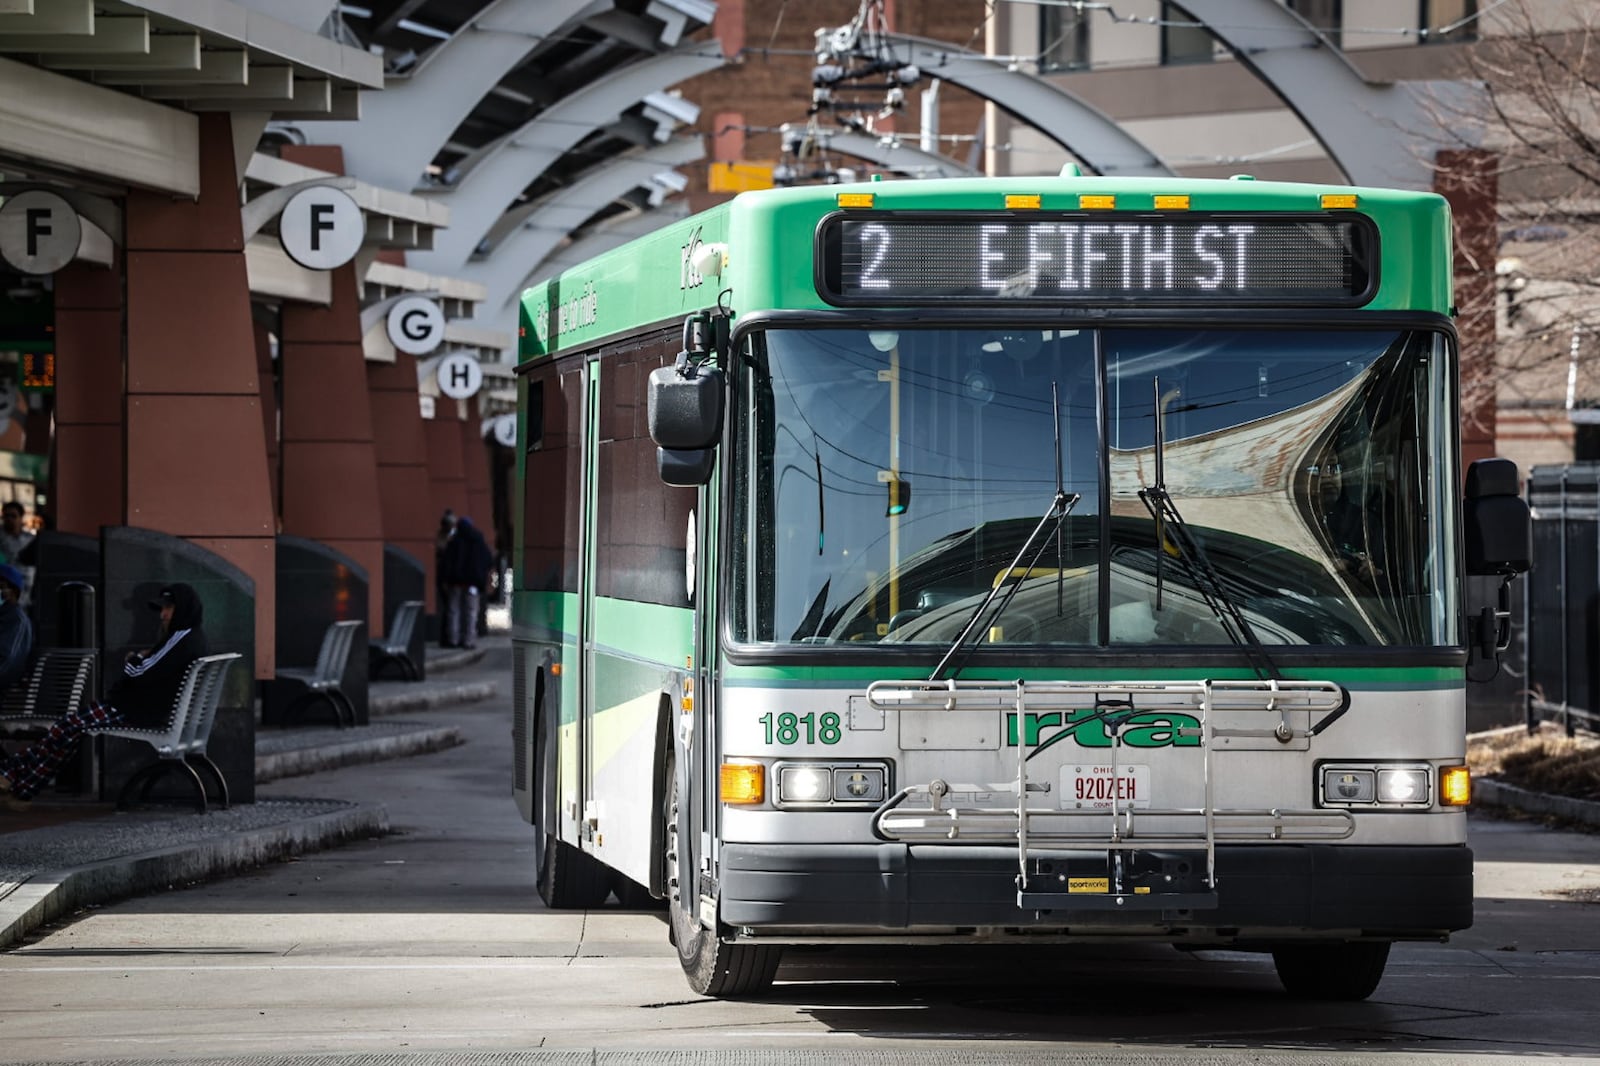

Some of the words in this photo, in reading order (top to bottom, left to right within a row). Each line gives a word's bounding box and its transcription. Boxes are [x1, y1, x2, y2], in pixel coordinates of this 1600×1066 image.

[26, 208, 52, 256] F
[310, 204, 335, 251] F
[859, 223, 891, 289] 2
[979, 223, 1007, 289] E
[1029, 223, 1175, 289] FIFTH
[1194, 223, 1255, 289] ST
[579, 280, 597, 328] ride
[401, 310, 433, 341] G
[451, 363, 469, 388] H
[758, 711, 842, 745] 1818
[1006, 708, 1202, 748] rta
[1075, 777, 1136, 800] 920ZEH
[1069, 881, 1107, 889] sportworks
